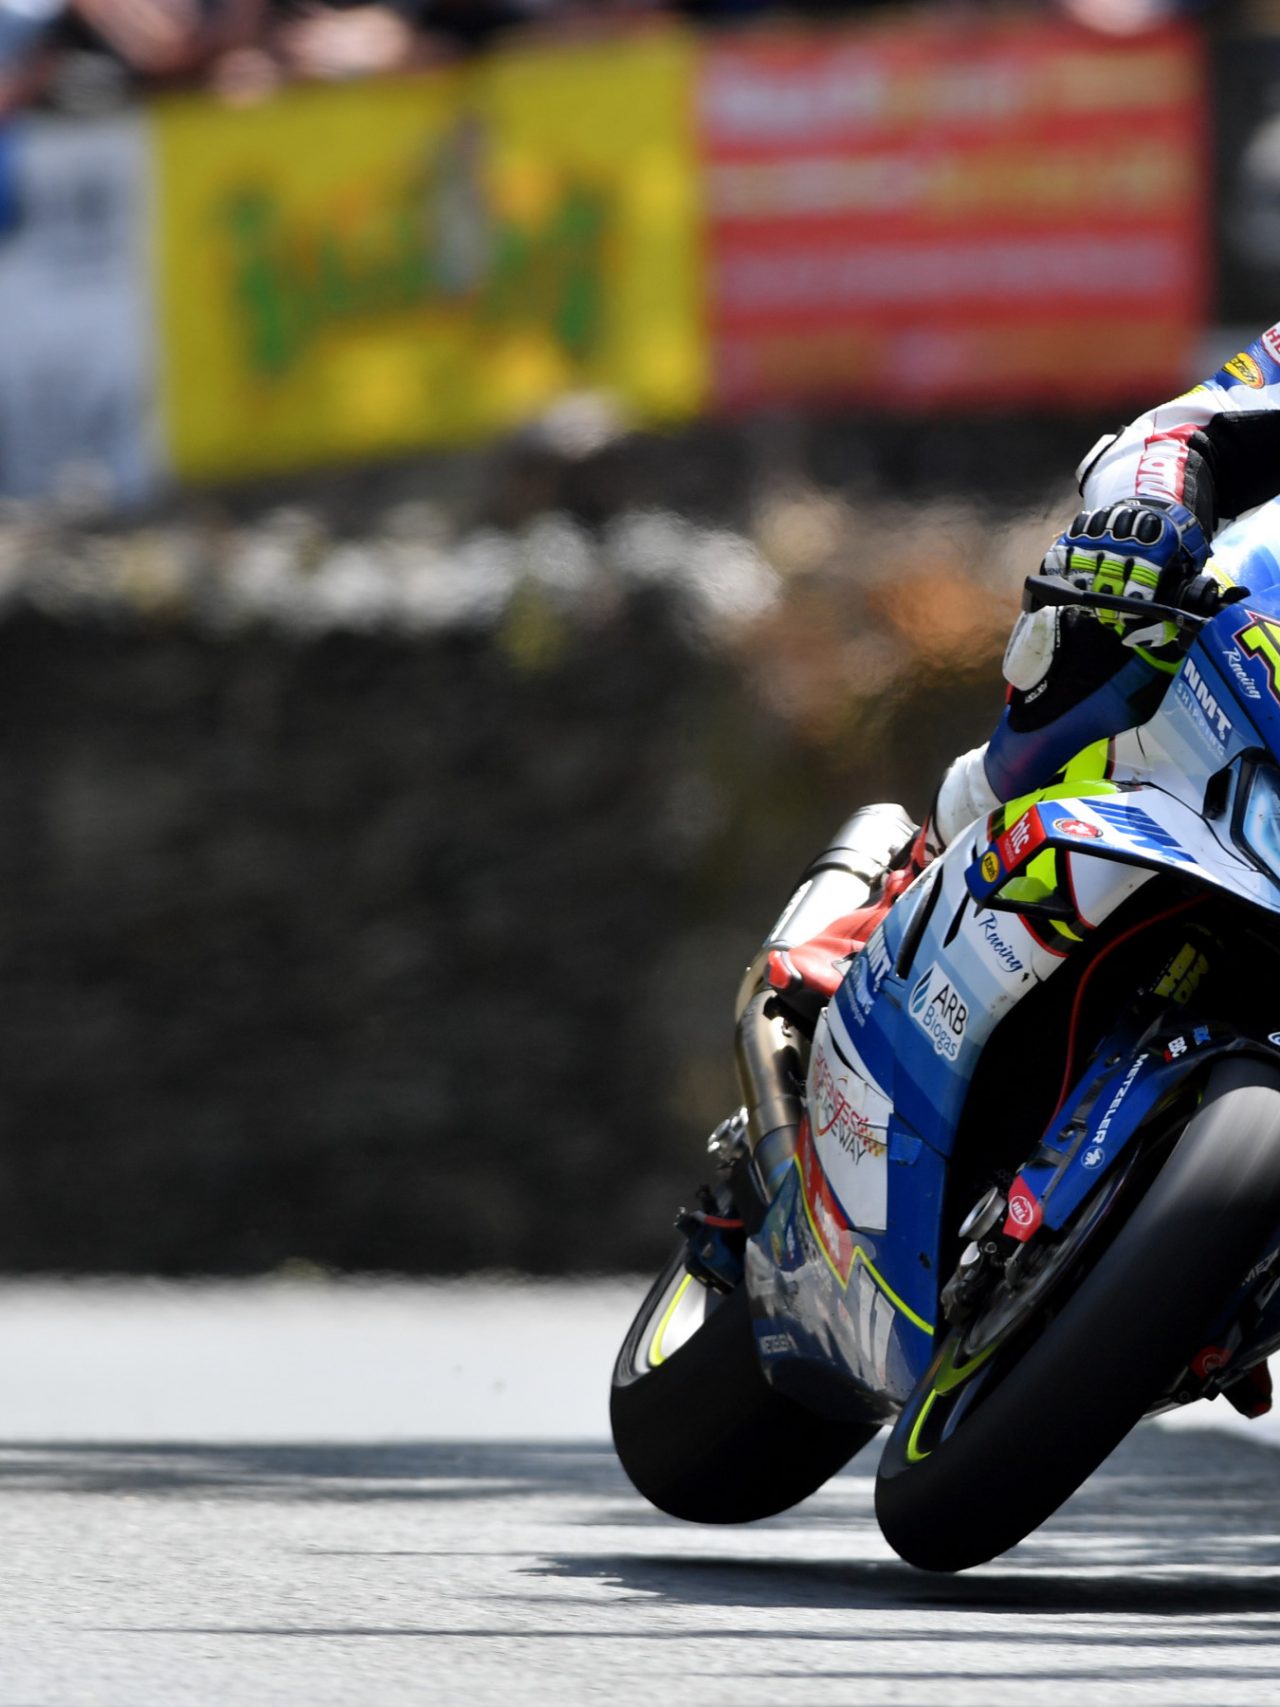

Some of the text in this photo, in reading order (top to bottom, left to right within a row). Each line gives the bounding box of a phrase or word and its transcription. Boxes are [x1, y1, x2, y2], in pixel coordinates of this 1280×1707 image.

[1136, 438, 1190, 503] MOTU
[1184, 657, 1232, 732] NMT
[1222, 646, 1262, 700] Racing
[1010, 811, 1031, 855] htc
[978, 911, 1024, 973] Racing
[922, 1004, 958, 1058] Biogas
[931, 983, 968, 1036] ARB
[1091, 1052, 1150, 1144] METZELER
